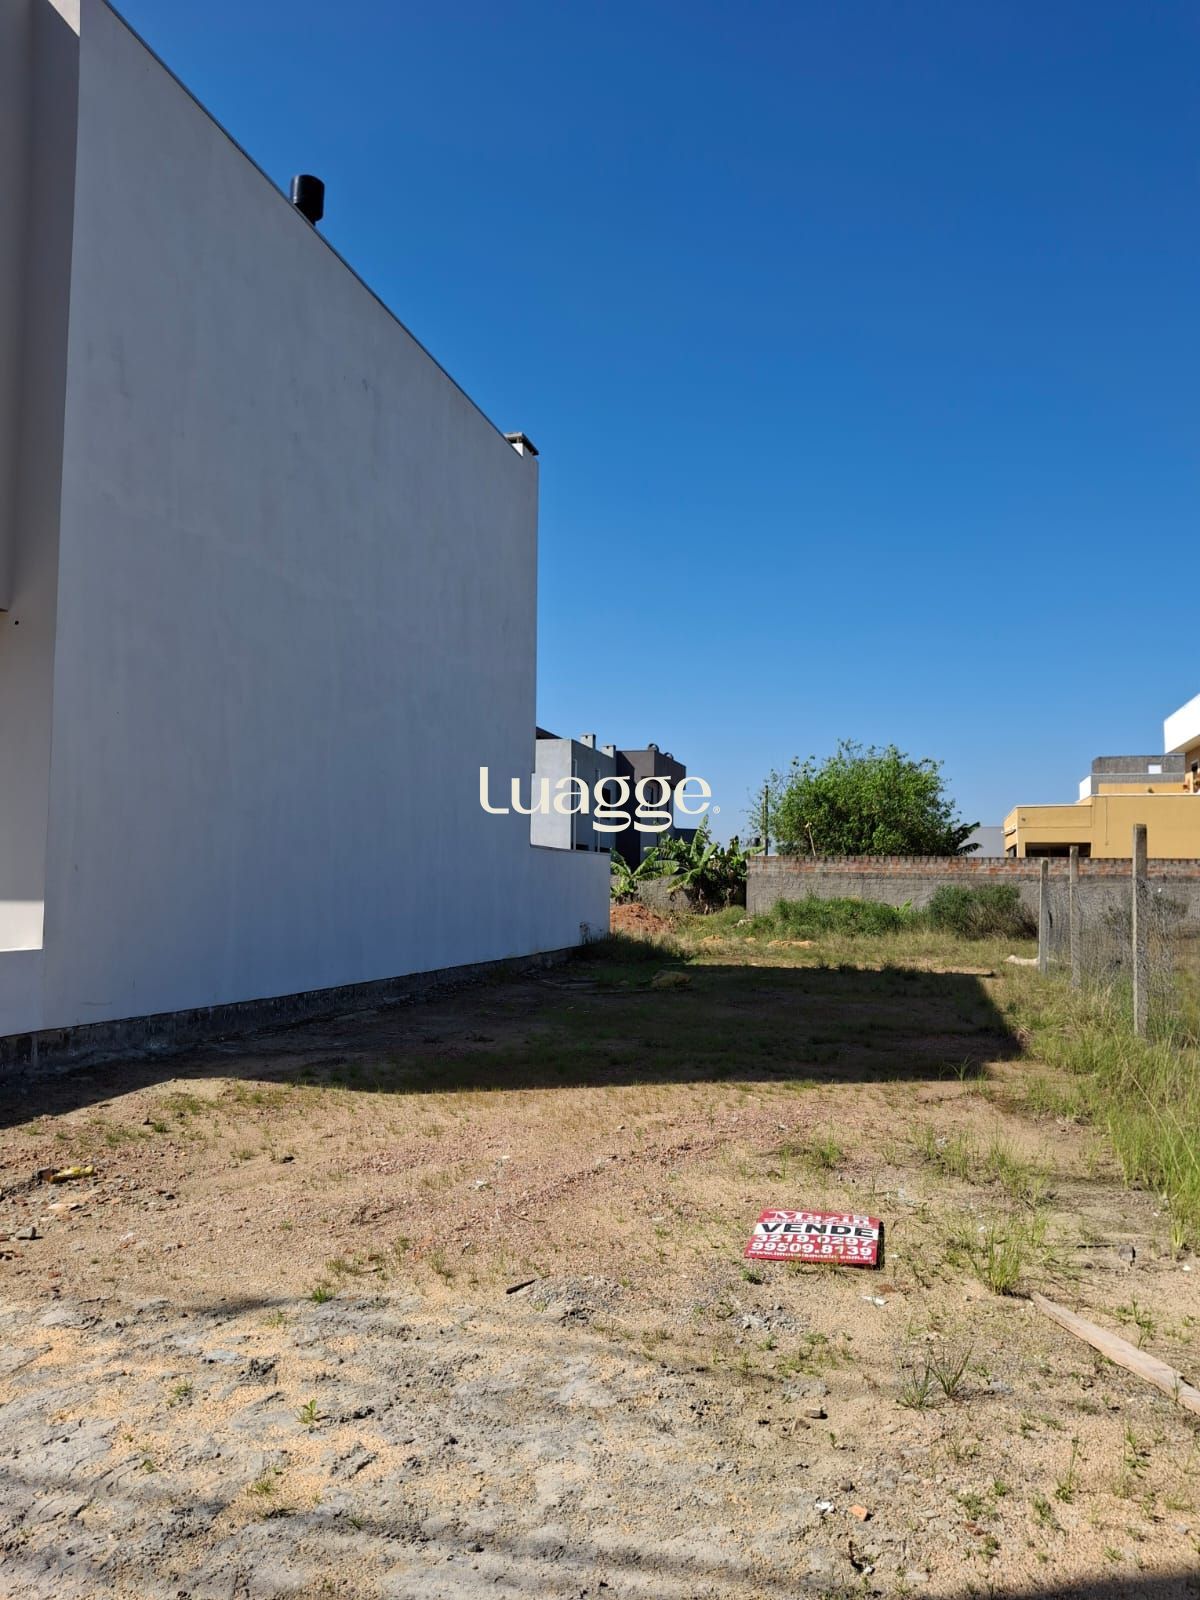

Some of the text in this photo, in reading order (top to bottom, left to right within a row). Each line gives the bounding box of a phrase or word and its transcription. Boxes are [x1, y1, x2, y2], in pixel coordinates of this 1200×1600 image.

[761, 1223, 874, 1238] VENDE
[756, 1235, 873, 1246] 3219.0297
[751, 1242, 873, 1256] 99509.8139
